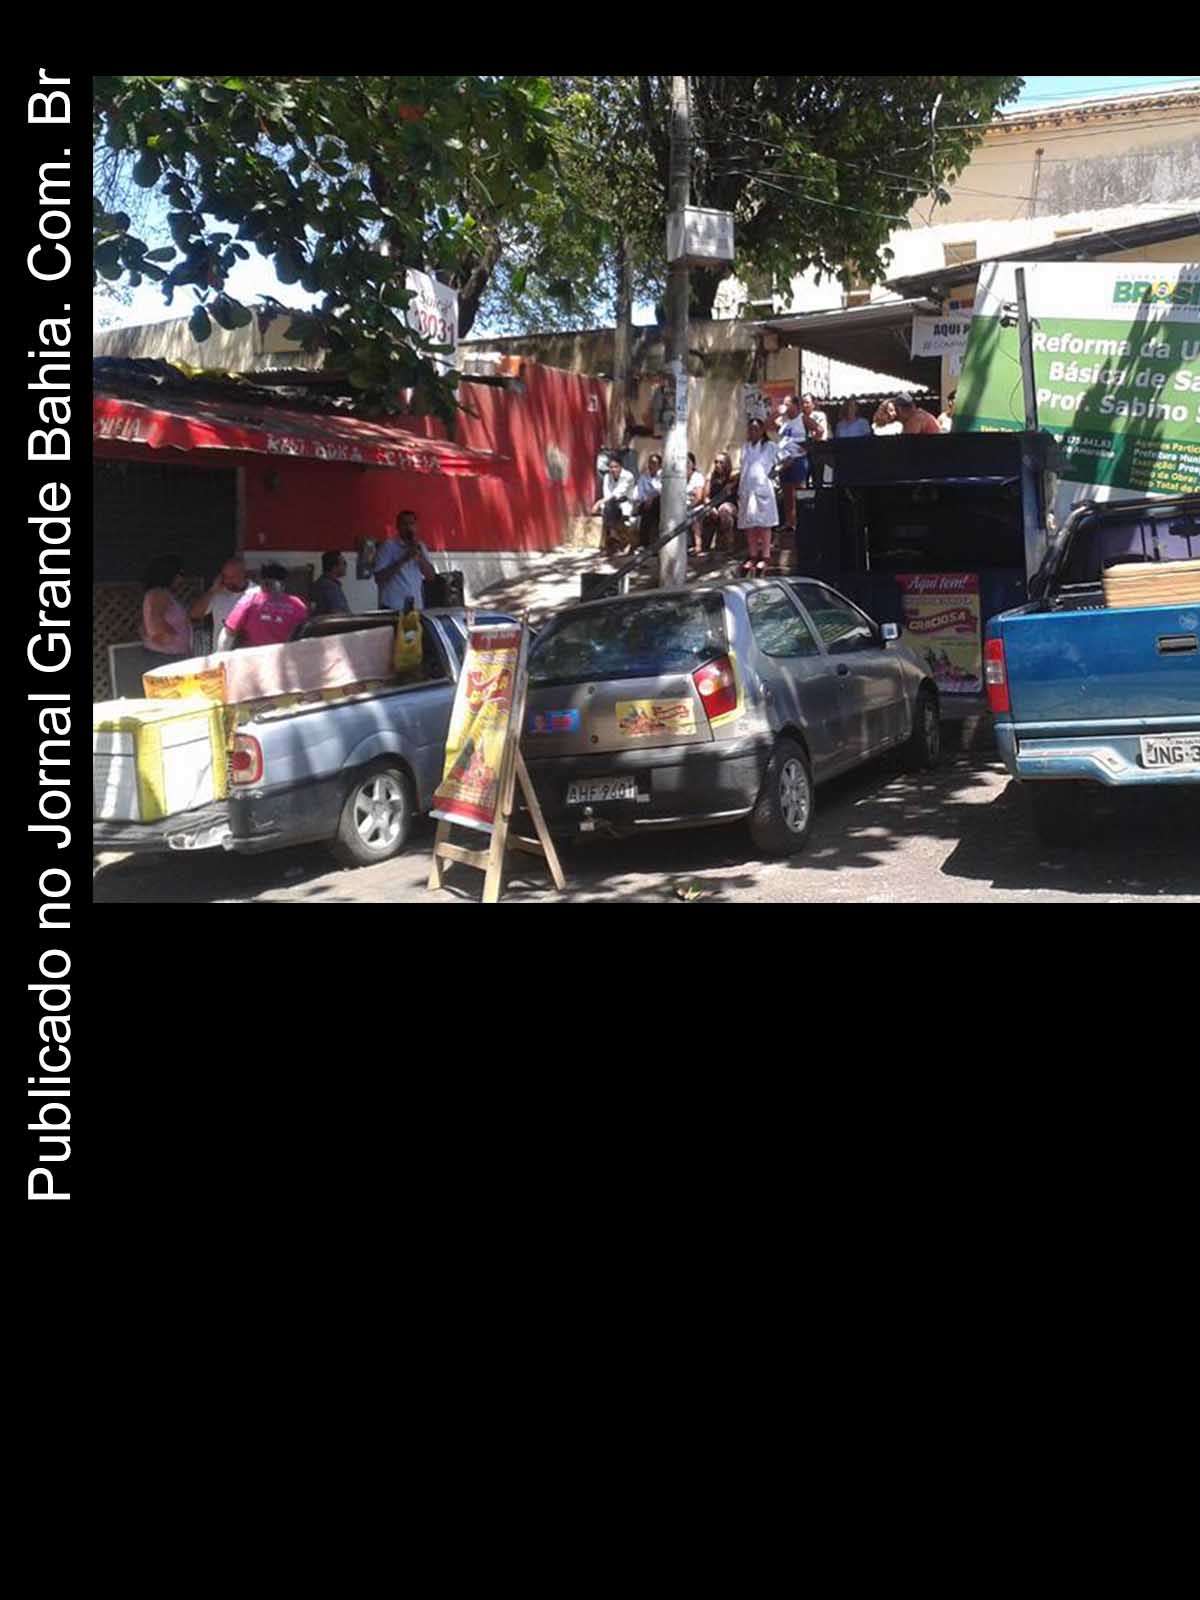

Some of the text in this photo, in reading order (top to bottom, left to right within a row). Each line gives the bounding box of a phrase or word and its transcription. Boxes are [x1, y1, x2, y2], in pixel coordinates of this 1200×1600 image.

[933, 323, 961, 336] AQUI
[1031, 331, 1130, 357] Reforma
[1140, 337, 1171, 361] da
[1048, 361, 1127, 386] Básica
[1135, 367, 1167, 390] de
[1037, 389, 1091, 412] Prof.
[1099, 394, 1188, 423] Sabino
